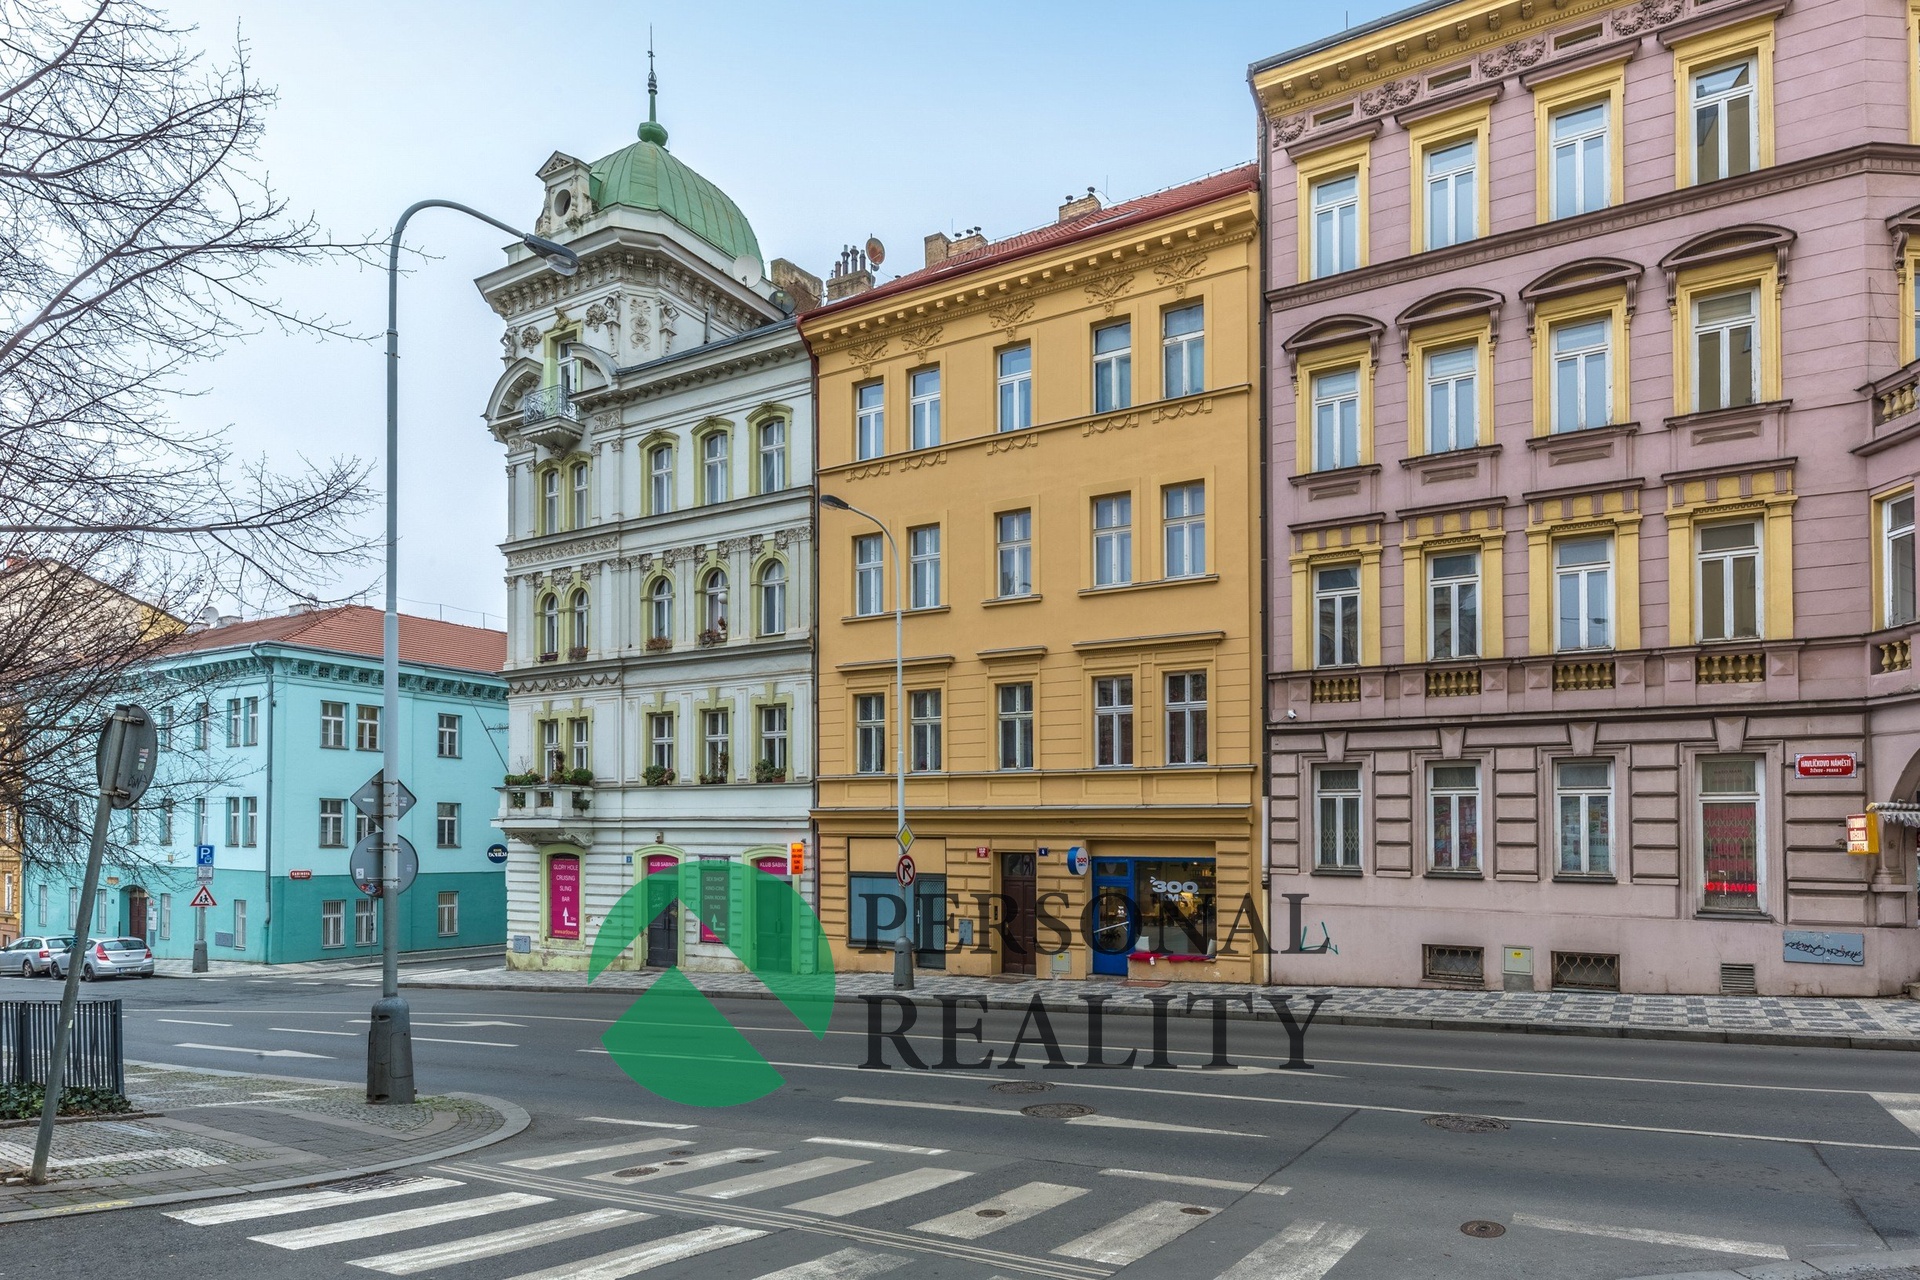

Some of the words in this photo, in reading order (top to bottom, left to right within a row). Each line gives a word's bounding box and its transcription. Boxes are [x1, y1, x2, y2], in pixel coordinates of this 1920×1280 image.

[1801, 759, 1830, 767] HAVLÍČKOVO
[1830, 758, 1851, 766] NÁMĚSTÍ
[201, 848, 210, 859] P
[1152, 881, 1198, 893] 300
